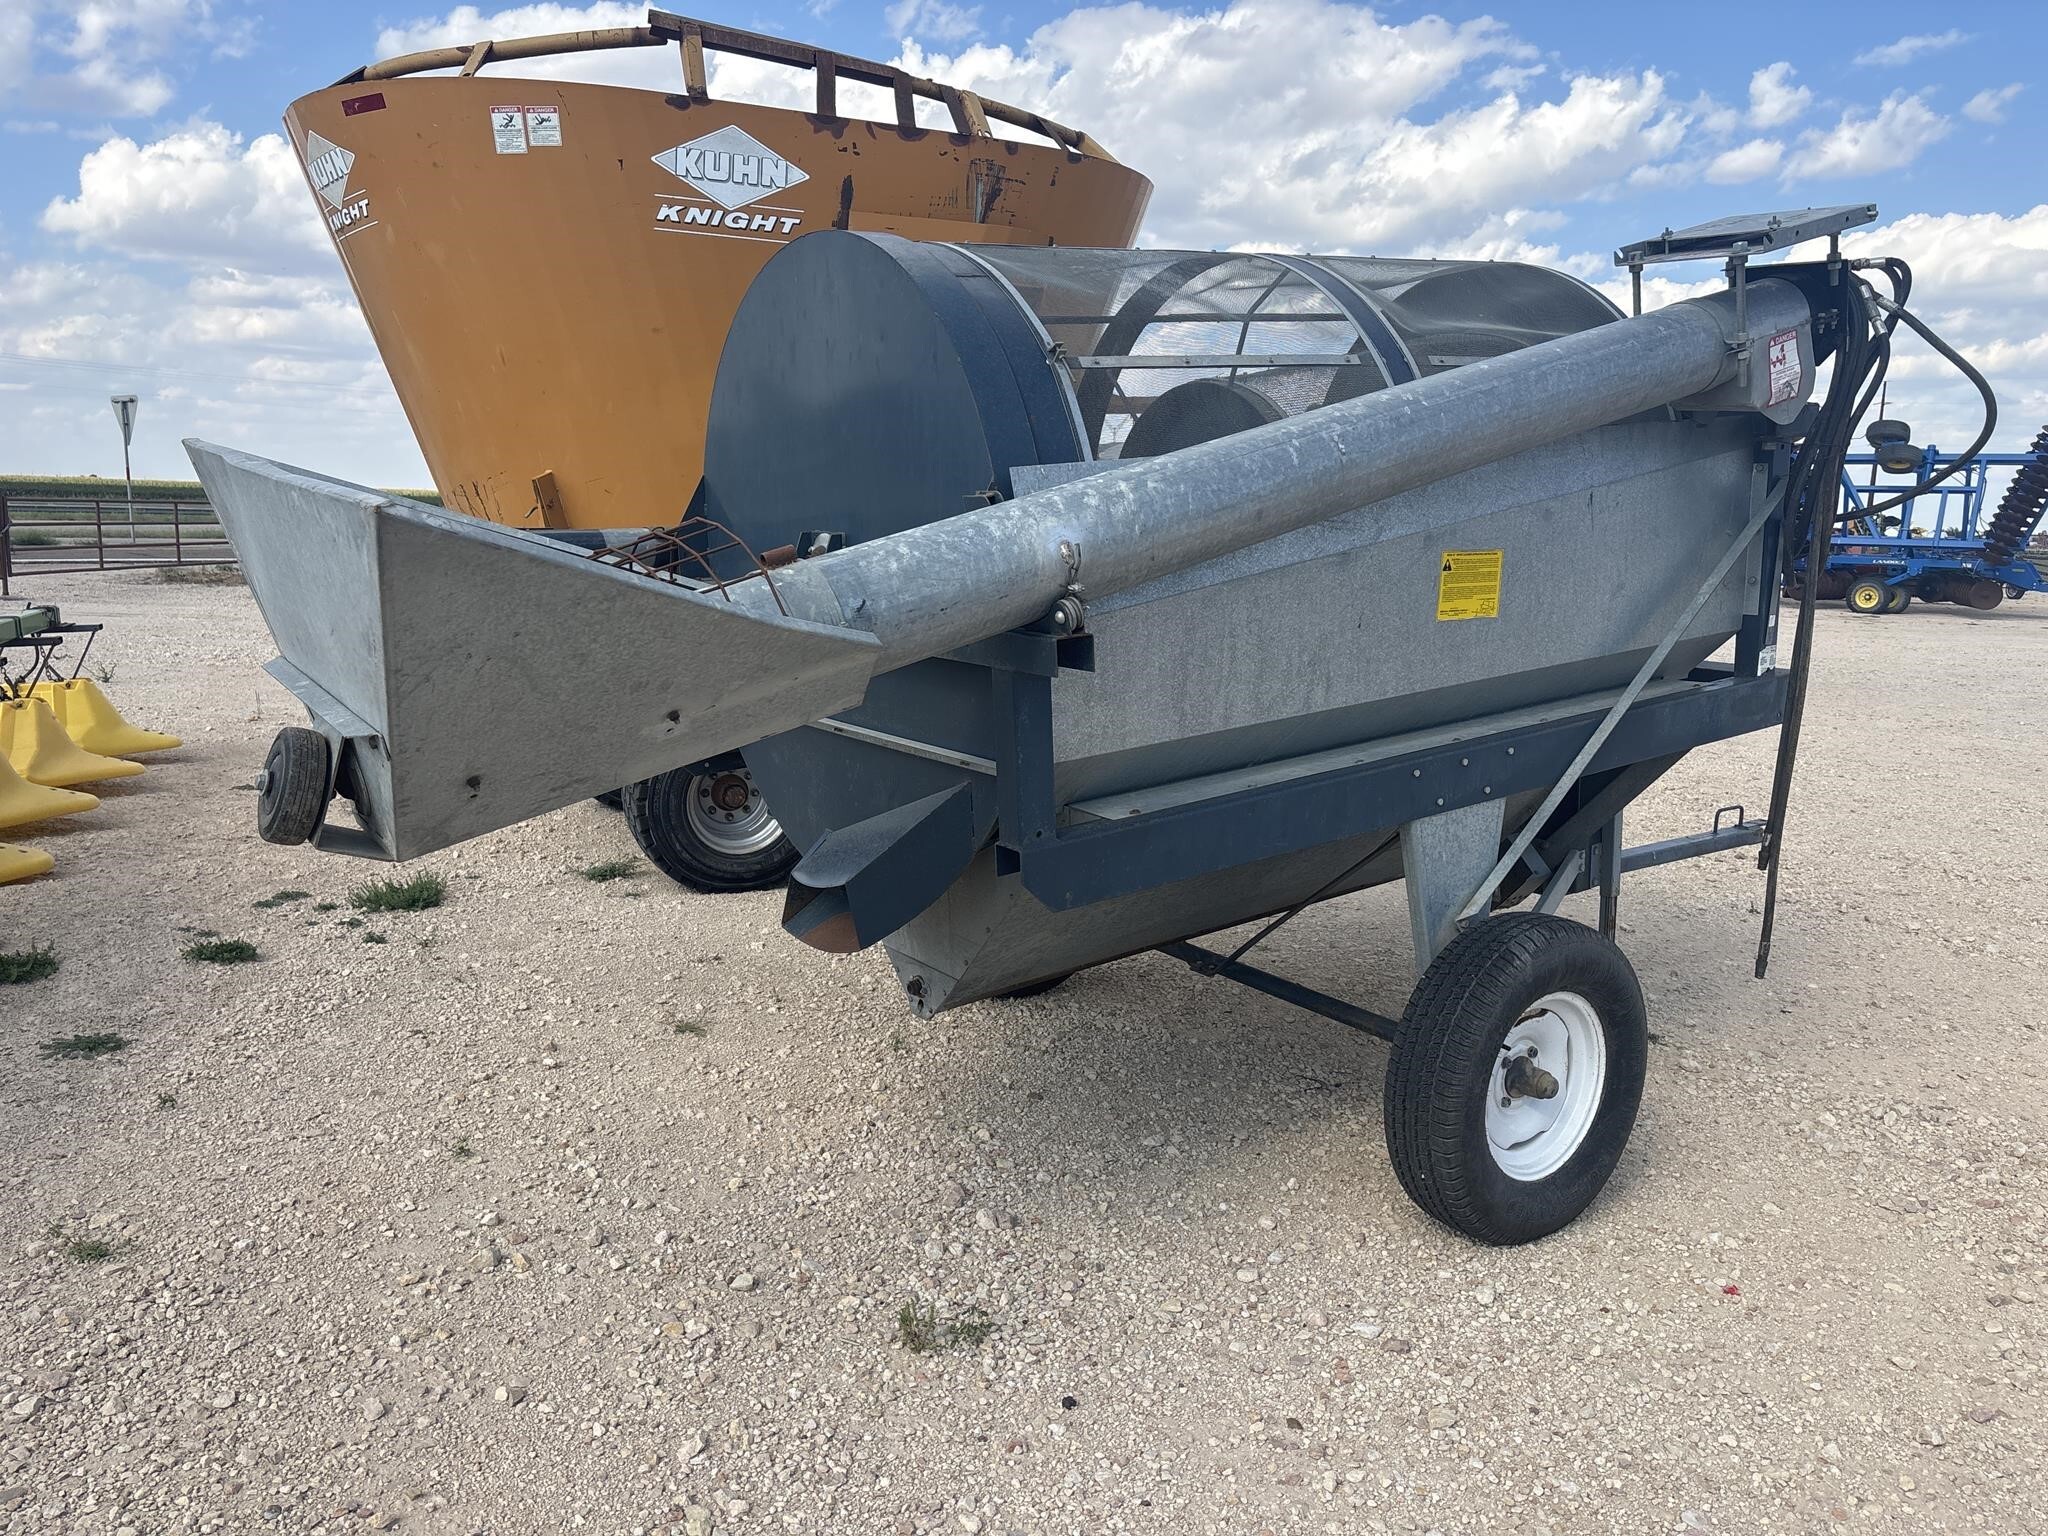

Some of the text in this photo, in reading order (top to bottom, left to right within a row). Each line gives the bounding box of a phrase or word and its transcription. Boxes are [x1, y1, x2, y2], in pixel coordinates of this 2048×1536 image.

[308, 147, 349, 191] KUHN
[675, 146, 787, 188] KUHN
[329, 199, 369, 232] KNIGHT
[656, 204, 802, 234] KNIGHT
[1775, 331, 1797, 345] DANGER
